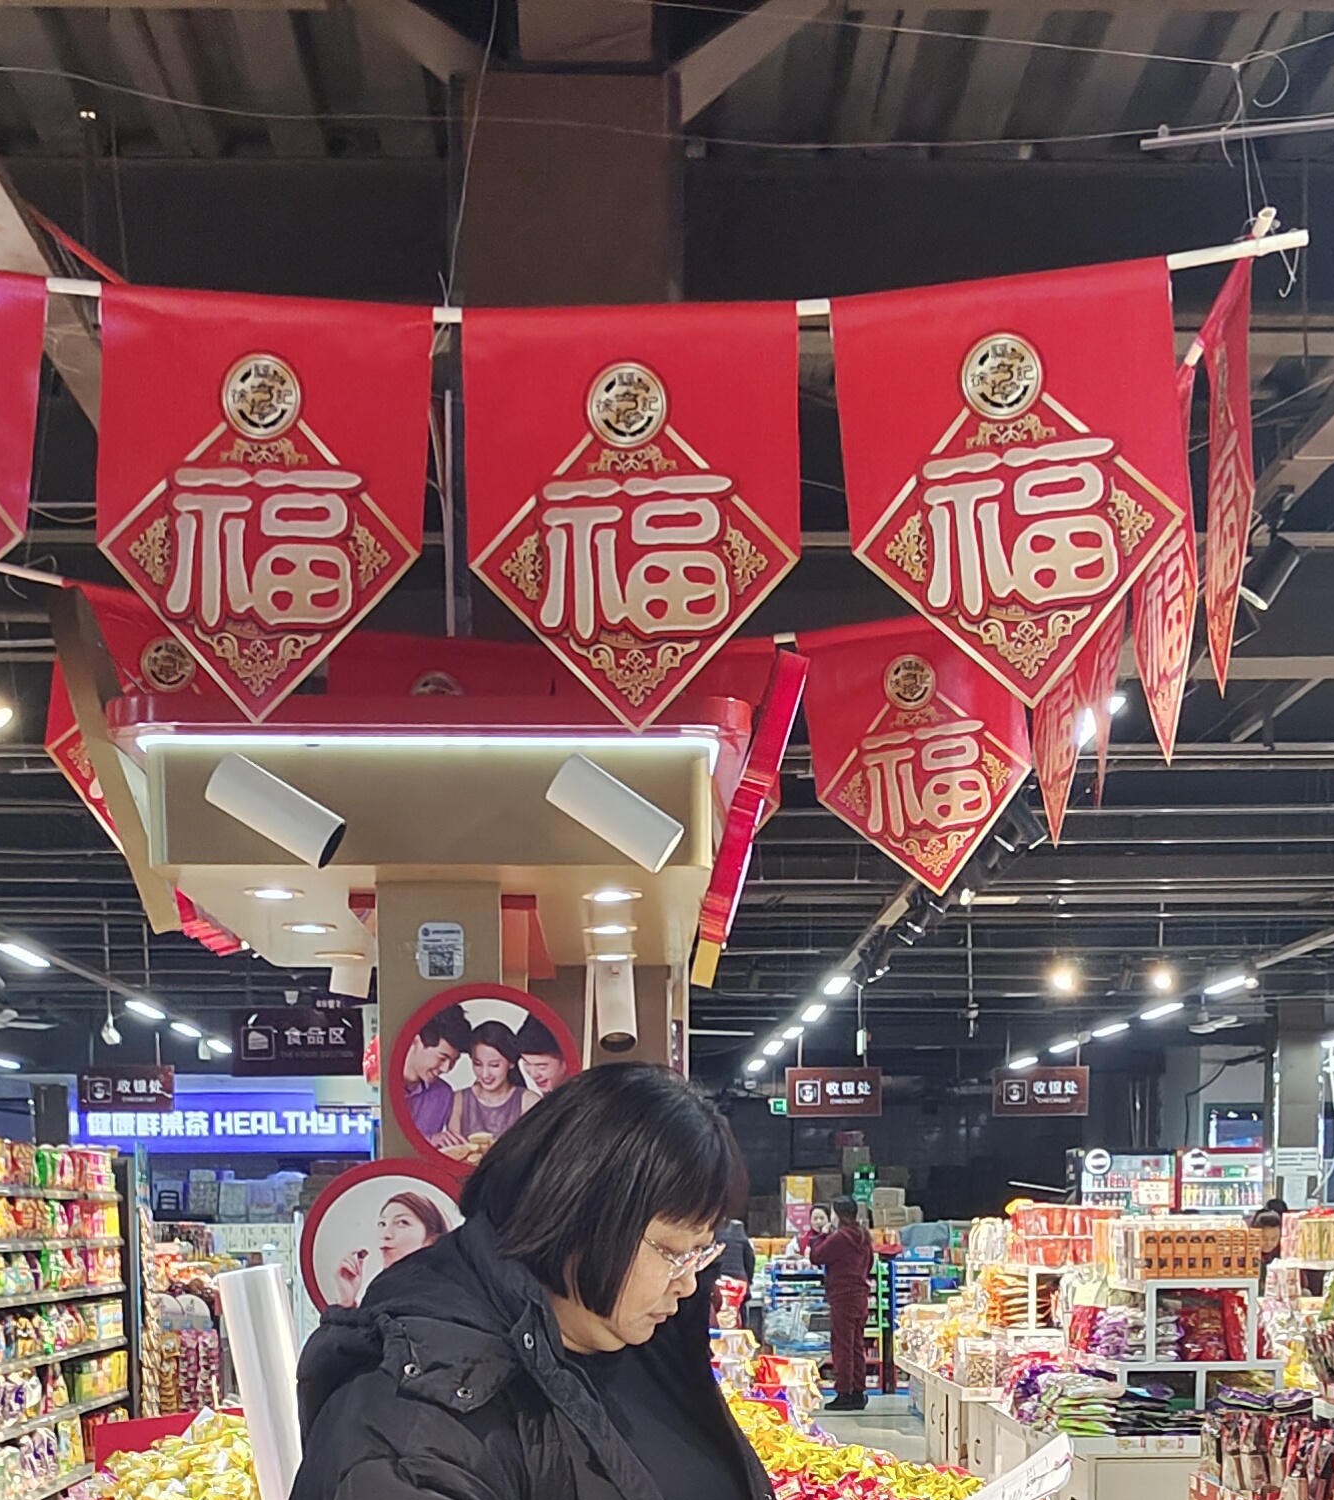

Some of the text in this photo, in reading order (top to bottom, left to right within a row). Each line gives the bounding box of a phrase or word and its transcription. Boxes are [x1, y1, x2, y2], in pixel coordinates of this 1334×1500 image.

[922, 434, 1117, 614] 福
[167, 465, 366, 630] 福
[537, 472, 734, 639] 福
[863, 719, 988, 838] 福
[284, 1026, 346, 1046] 食品区
[117, 1079, 163, 1095] 收银处
[825, 1080, 872, 1096] 收银处
[1032, 1080, 1079, 1096] 收银处
[214, 1110, 336, 1136] HEALTHY
